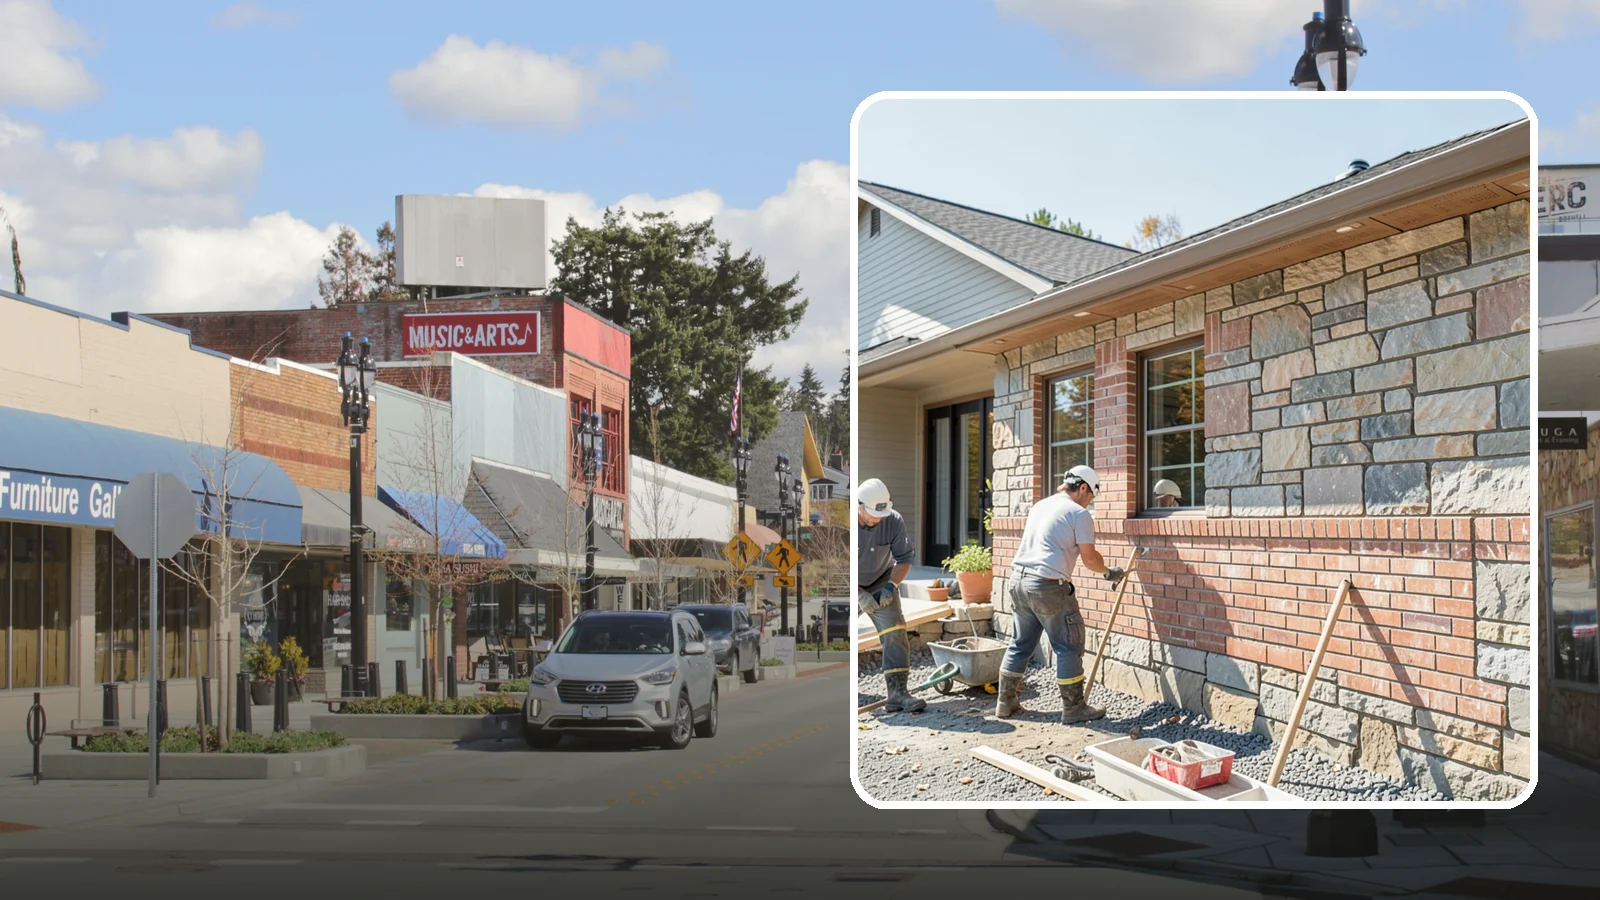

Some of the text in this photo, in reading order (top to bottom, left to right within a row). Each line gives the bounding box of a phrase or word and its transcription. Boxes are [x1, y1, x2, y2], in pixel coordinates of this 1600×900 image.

[1540, 427, 1578, 436] UGA
[0, 471, 80, 515] Furniture
[453, 563, 480, 574] SUSHI
